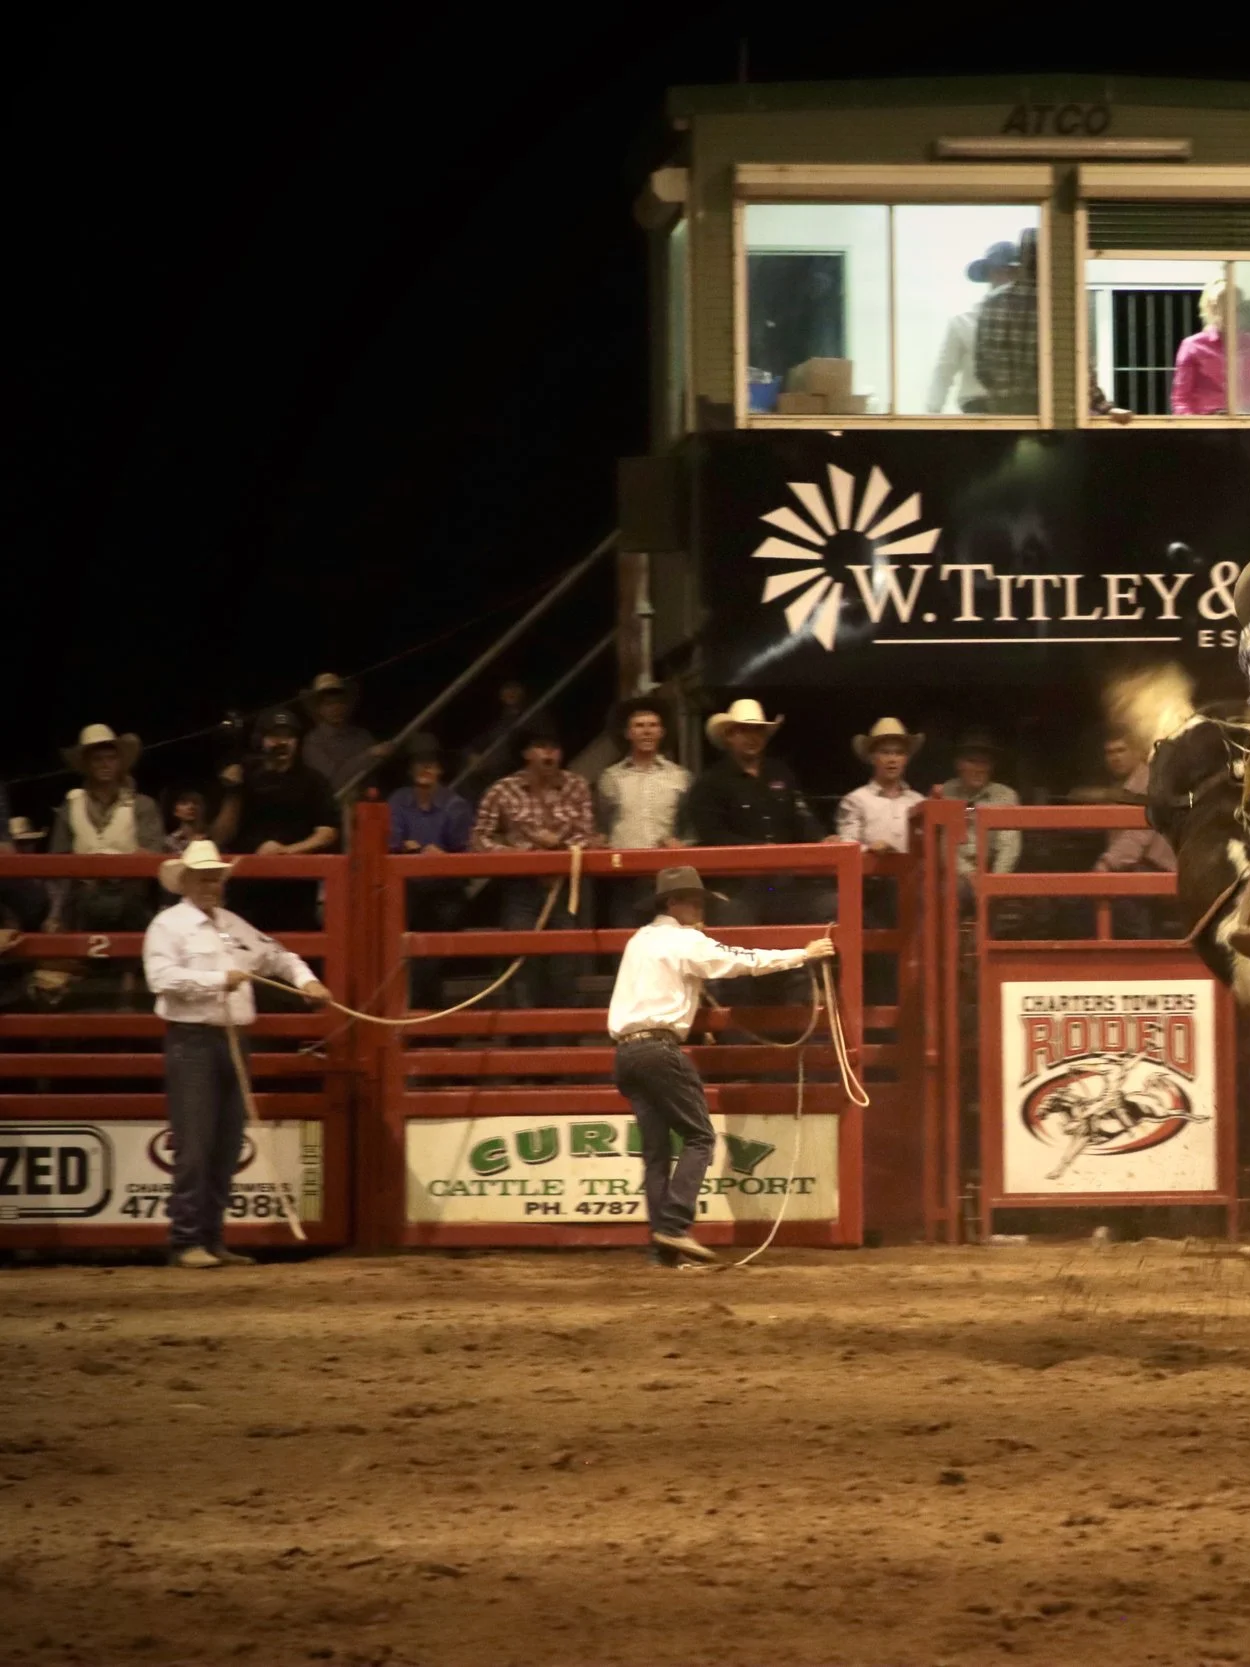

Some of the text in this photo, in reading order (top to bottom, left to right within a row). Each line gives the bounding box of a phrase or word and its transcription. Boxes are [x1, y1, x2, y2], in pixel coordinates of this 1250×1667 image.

[1002, 104, 1112, 135] ATCO
[1197, 560, 1240, 621] &
[86, 935, 111, 959] 2
[1022, 994, 1197, 1013] CHARTERS TOWERS
[1019, 1014, 1199, 1088] RODEO
[427, 1177, 816, 1197] CATTLE TRASPORT
[575, 1201, 640, 1215] 4787
